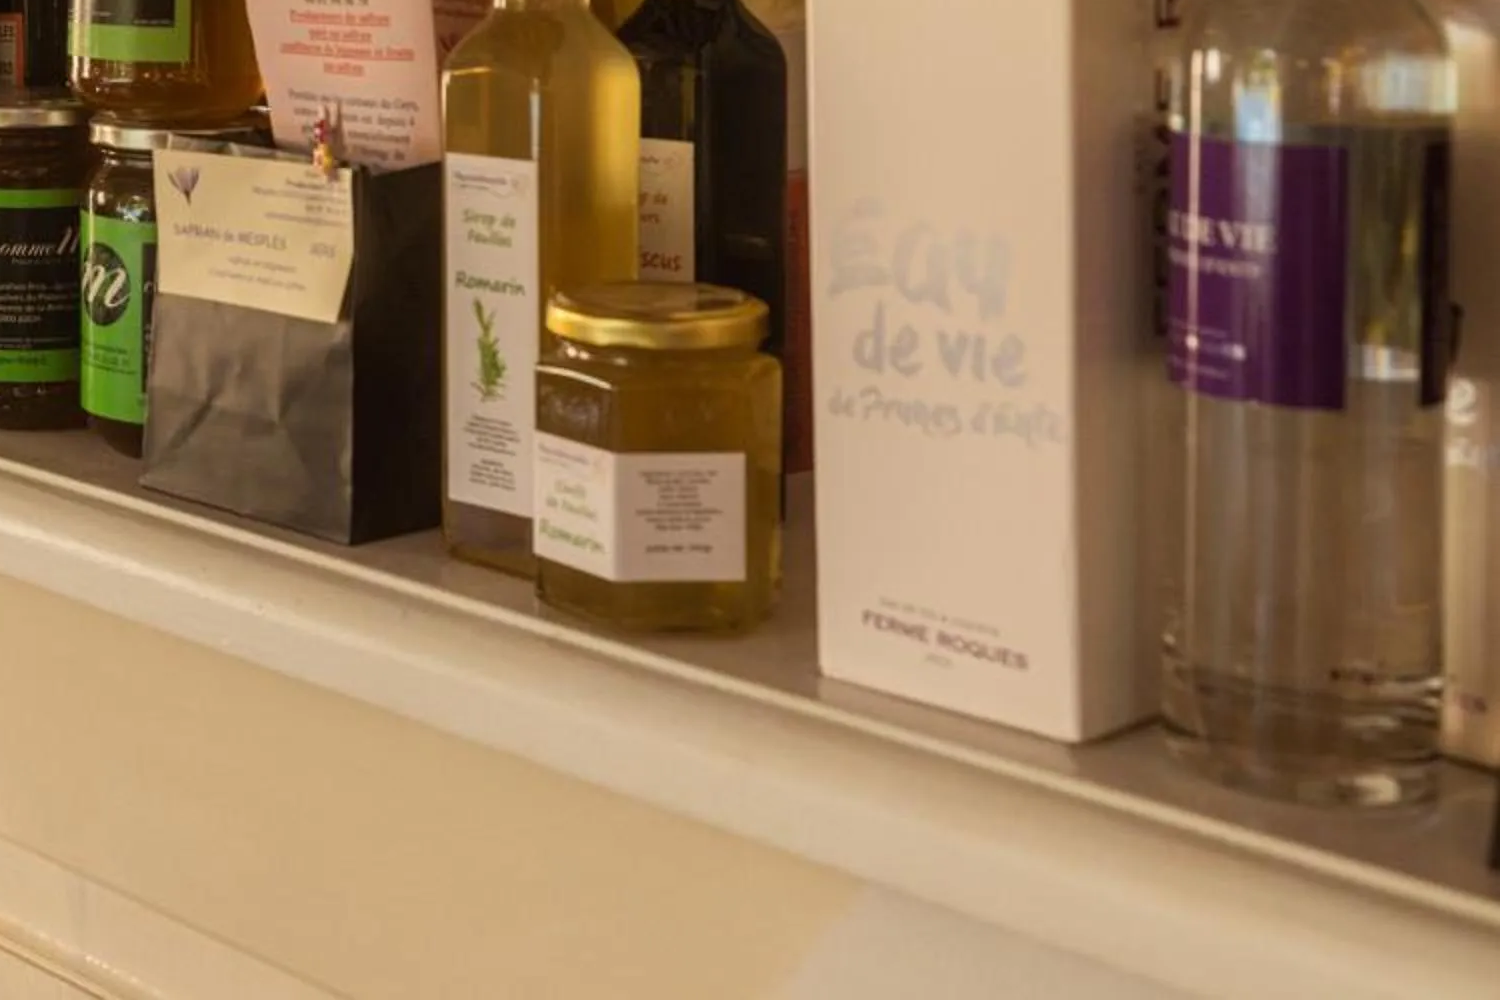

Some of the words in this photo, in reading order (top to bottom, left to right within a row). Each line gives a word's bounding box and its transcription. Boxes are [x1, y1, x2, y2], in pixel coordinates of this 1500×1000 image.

[454, 269, 527, 298] Romarin
[852, 300, 924, 378] de
[936, 329, 1030, 387] vie
